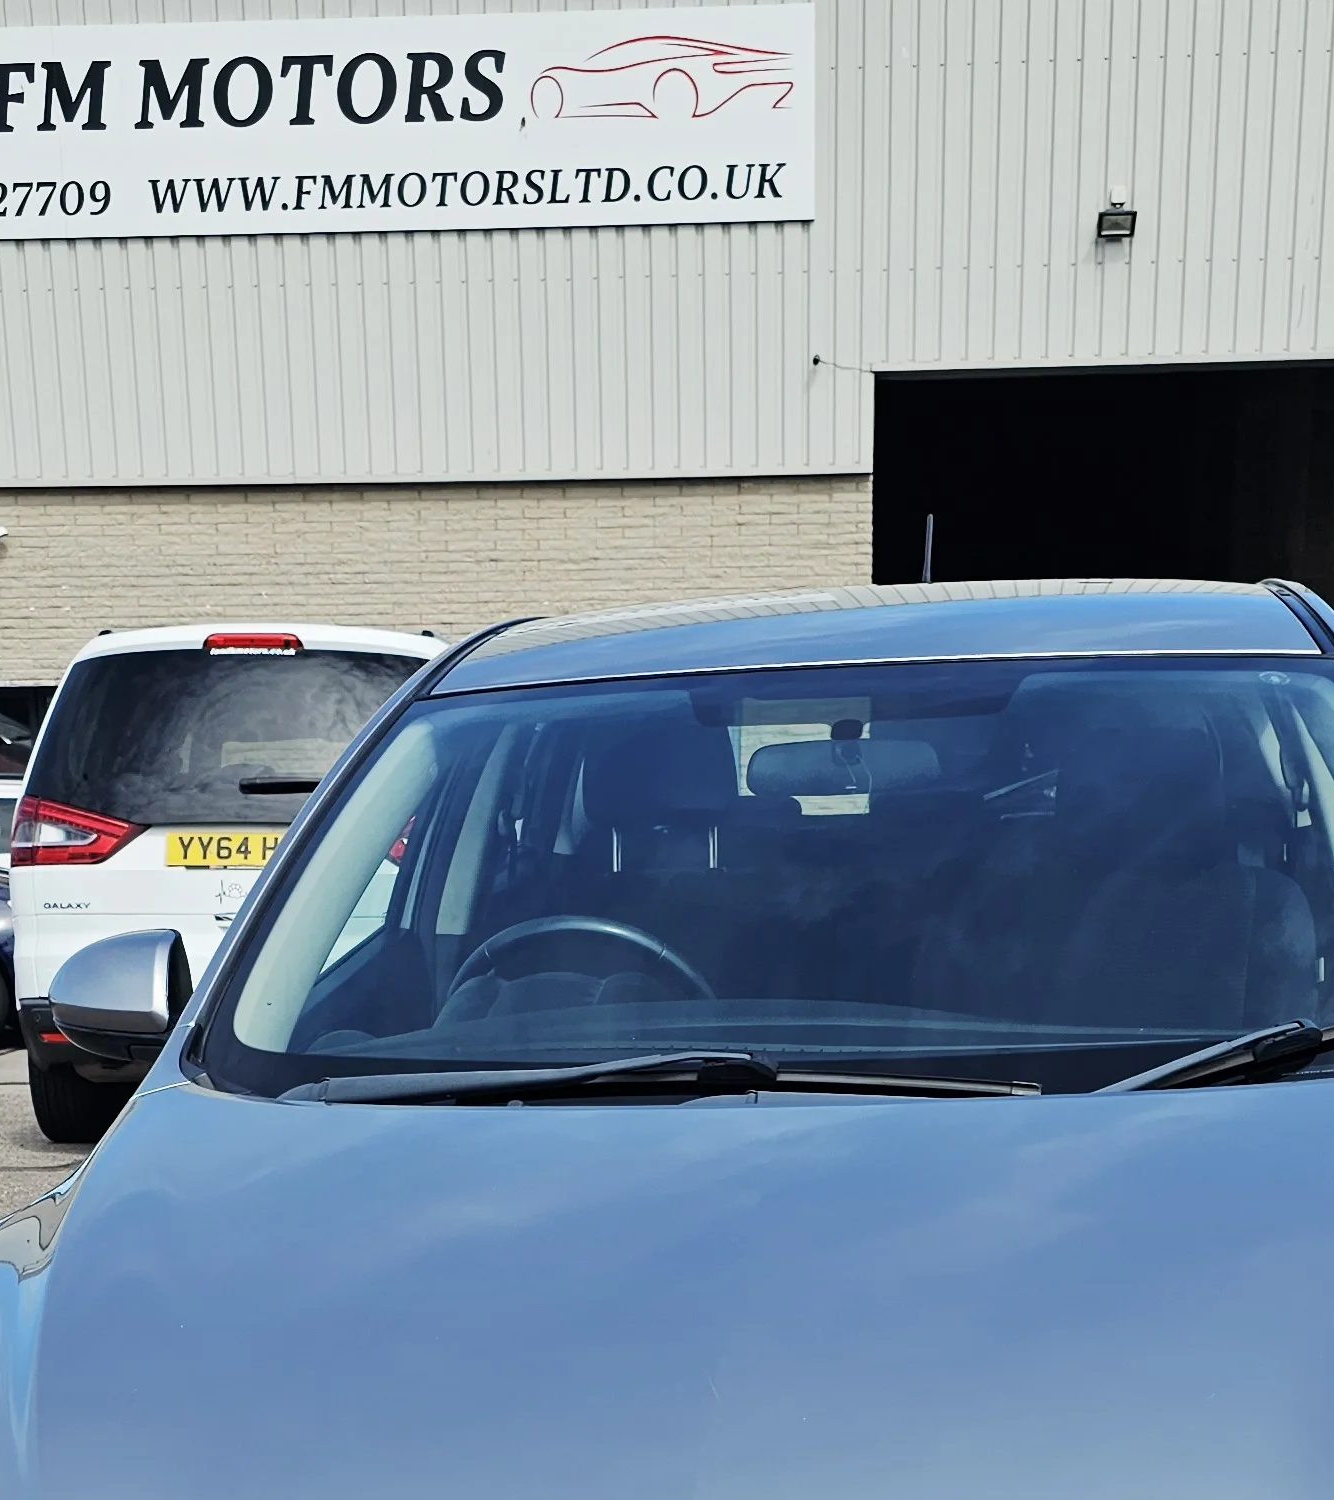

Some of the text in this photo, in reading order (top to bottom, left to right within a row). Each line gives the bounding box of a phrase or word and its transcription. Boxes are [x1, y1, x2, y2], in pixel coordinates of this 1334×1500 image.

[134, 49, 506, 130] MOTORS
[148, 163, 787, 213] WWW.FMMOTORSLTD.CO.UK
[178, 836, 252, 860] YY64
